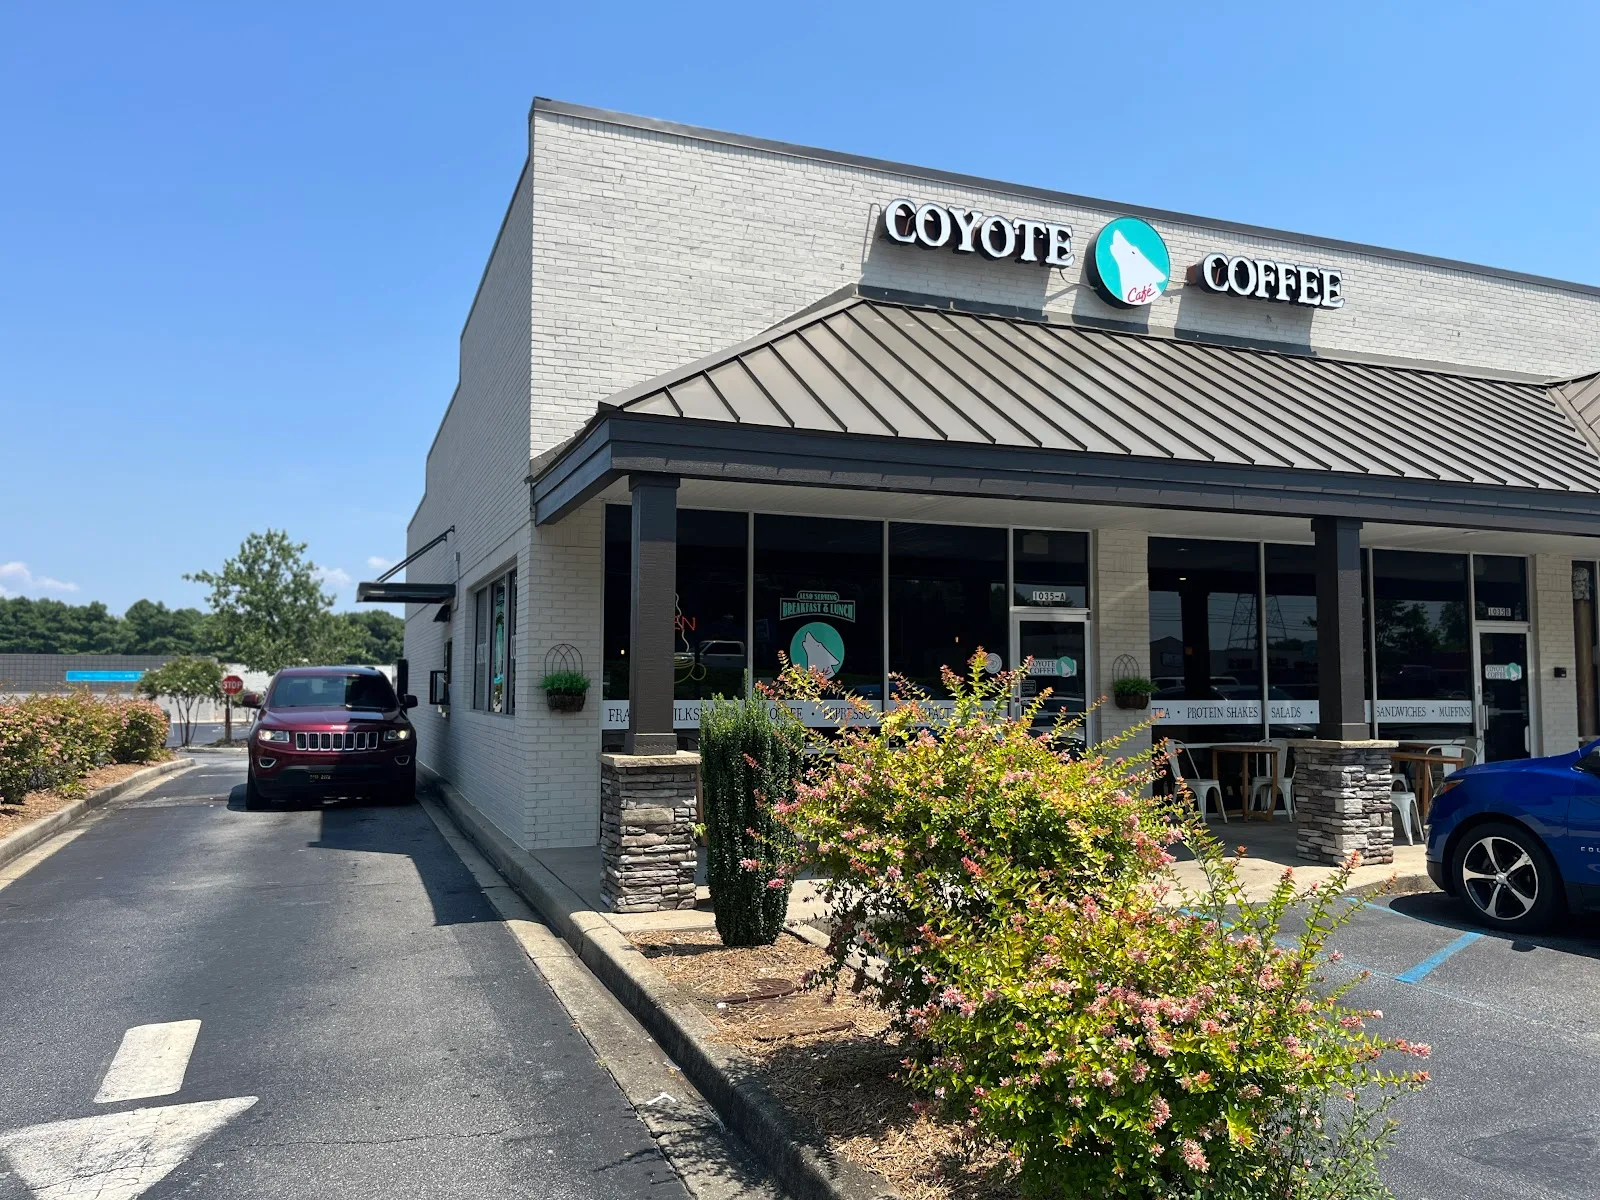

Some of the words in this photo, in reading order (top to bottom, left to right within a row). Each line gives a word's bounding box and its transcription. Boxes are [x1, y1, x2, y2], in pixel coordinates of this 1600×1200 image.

[885, 199, 1075, 267] COYOTE
[1203, 252, 1346, 308] COFFEE
[1127, 283, 1156, 303] Café
[1034, 592, 1065, 601] 1035-A
[782, 601, 822, 617] BREAKFAST
[830, 603, 854, 619] LUNCH
[223, 681, 243, 689] STOP
[1152, 707, 1171, 719] TEA
[1187, 706, 1224, 720] PROTEIN
[1226, 706, 1259, 719] SHAKES
[1271, 706, 1302, 719] SALADS
[1376, 706, 1427, 718] SANDWICHES
[1439, 706, 1471, 718] MUFFINS
